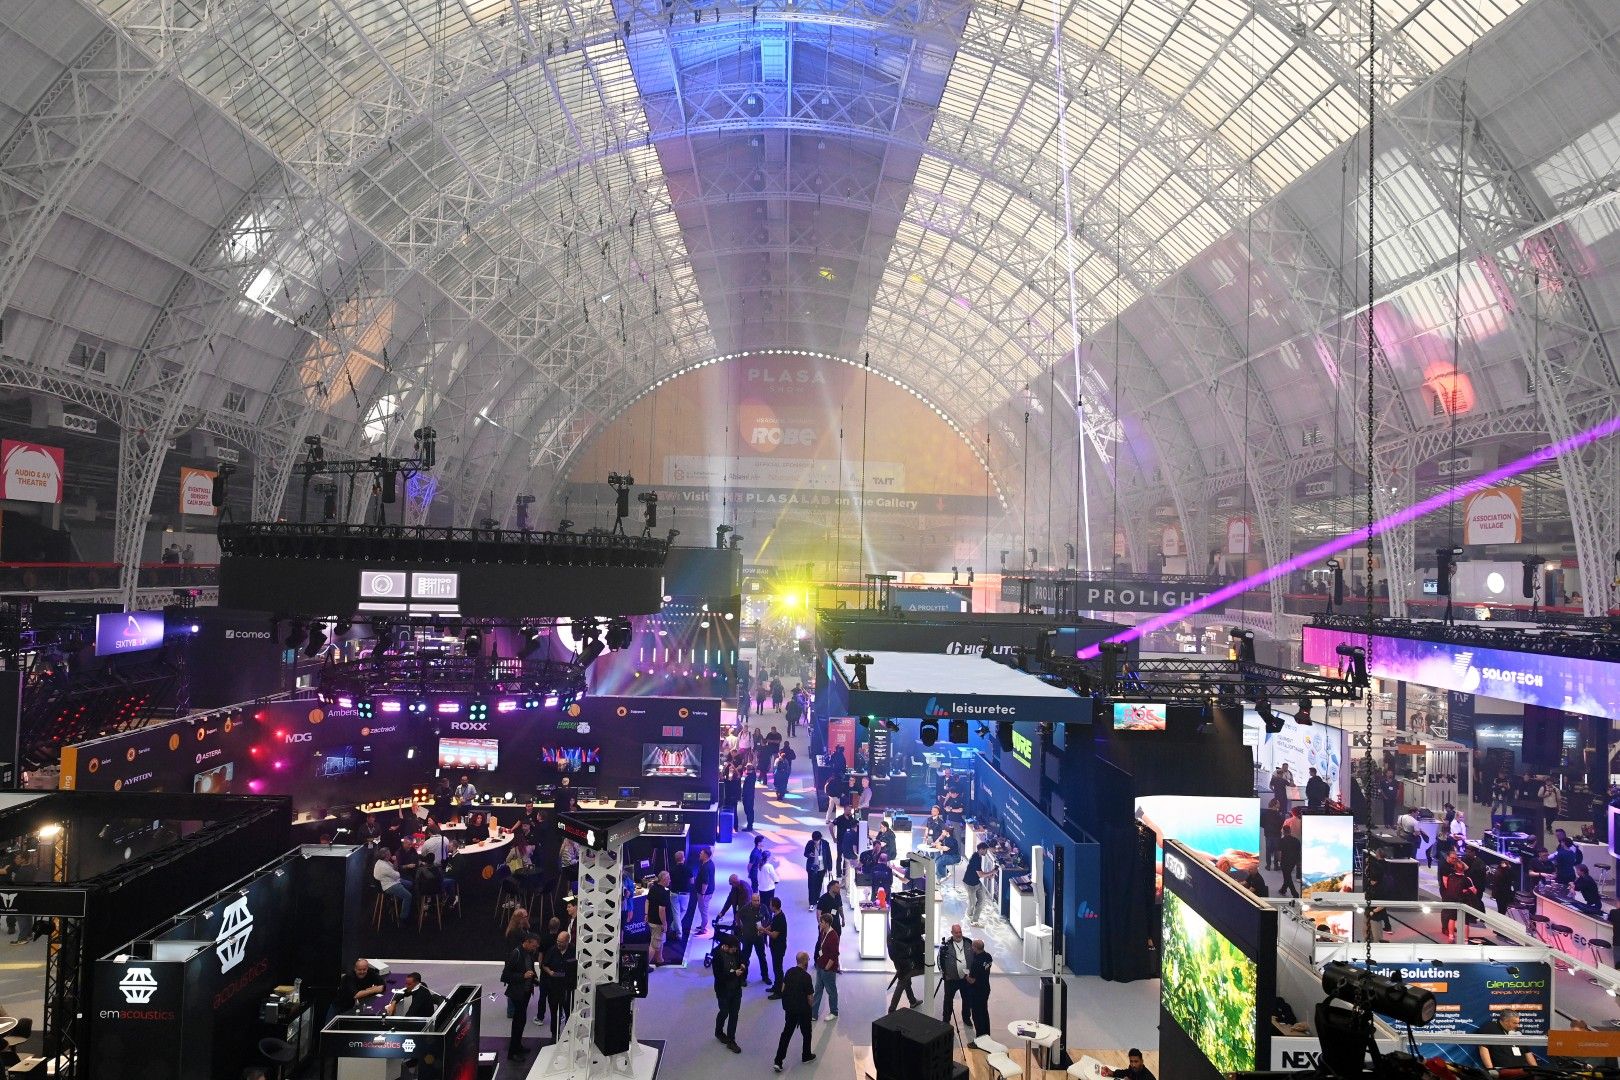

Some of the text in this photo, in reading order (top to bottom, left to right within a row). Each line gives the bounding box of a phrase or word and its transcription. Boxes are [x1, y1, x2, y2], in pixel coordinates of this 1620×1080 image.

[747, 368, 825, 383] PLASA
[15, 468, 36, 478] AUDIO
[41, 471, 51, 479] AV
[17, 477, 47, 487] THEATRE
[682, 491, 711, 502] Visit
[835, 497, 850, 506] on
[875, 498, 918, 509] Gallery
[1472, 513, 1512, 522] ASSOCIATION
[1480, 521, 1504, 530] VILLAGE
[236, 631, 271, 639] cameo
[963, 644, 1018, 655] HIGLIT
[1482, 667, 1544, 688] SOLOTECH
[952, 702, 1016, 715] leisuretec
[370, 726, 398, 734] zactrack
[451, 722, 488, 731] ROXX
[285, 732, 313, 744] MDG
[202, 748, 222, 760] ASTERA
[123, 771, 153, 786] AYRTON
[1216, 813, 1243, 825] ROE
[625, 921, 646, 931] sphere
[1400, 967, 1460, 979] Solutions
[1486, 980, 1545, 989] Glensound
[99, 1008, 176, 1020] emacoustics
[1281, 1051, 1322, 1069] NEX
